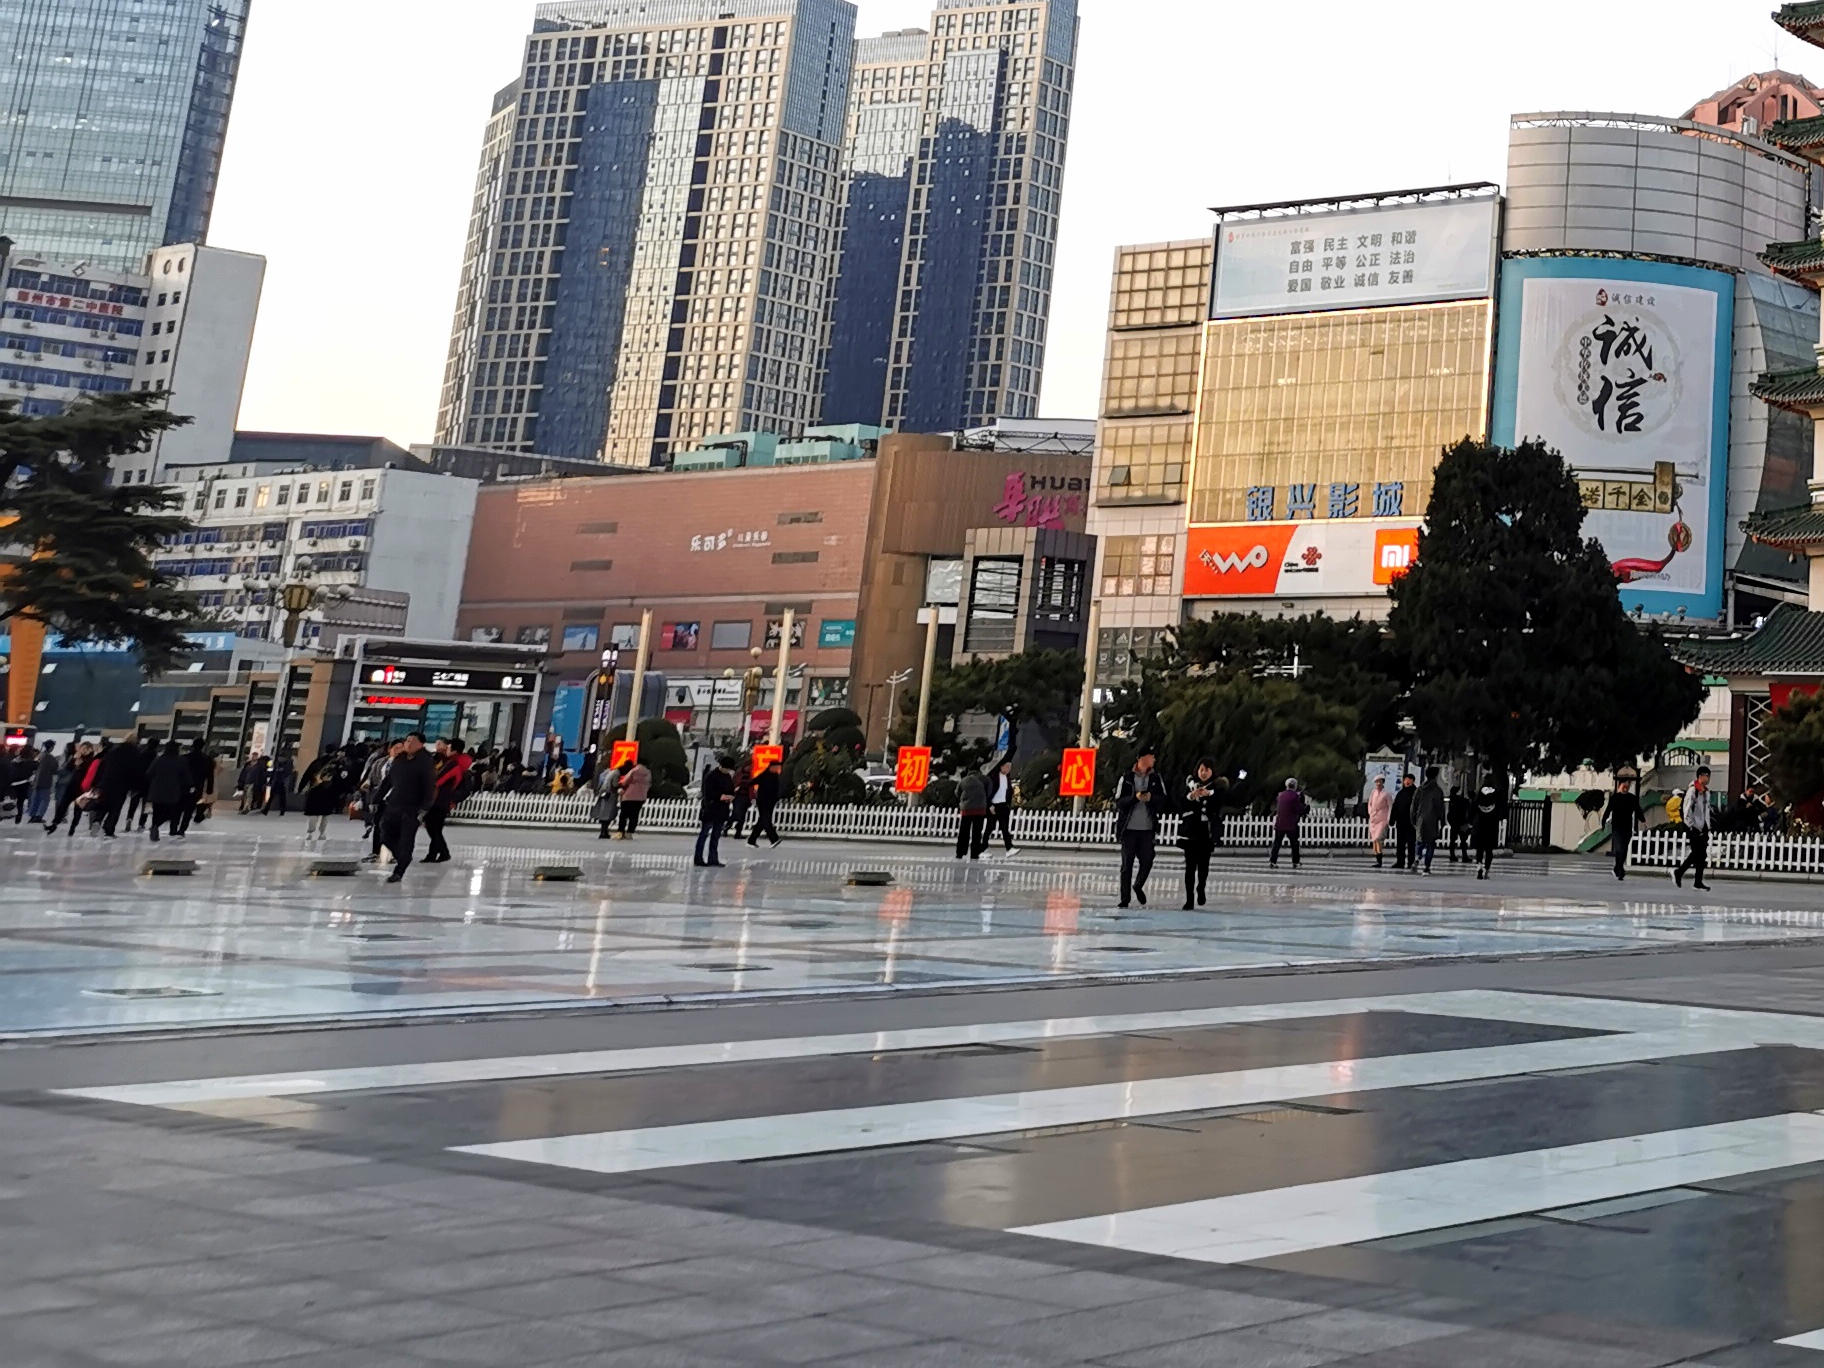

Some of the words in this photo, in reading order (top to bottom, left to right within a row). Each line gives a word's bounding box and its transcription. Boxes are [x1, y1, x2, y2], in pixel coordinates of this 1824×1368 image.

[1290, 239, 1315, 256] 富强
[1323, 236, 1348, 252] 民主
[1356, 233, 1382, 249] 文明
[1390, 230, 1417, 246] 和谐
[1289, 259, 1313, 275] 自由
[1321, 256, 1347, 271] 平等
[1355, 253, 1381, 268] 公正
[1389, 250, 1416, 265] 法治
[1287, 278, 1312, 293] 爱国
[1320, 275, 1346, 291] 敬业
[1354, 272, 1380, 288] 诚信
[1388, 269, 1414, 285] 友善
[1611, 292, 1656, 307] 诚信建设
[1246, 482, 1405, 521] 银兴影城
[1582, 485, 1653, 508] 诺千金
[901, 751, 926, 787] 初
[1064, 754, 1091, 790] 心
